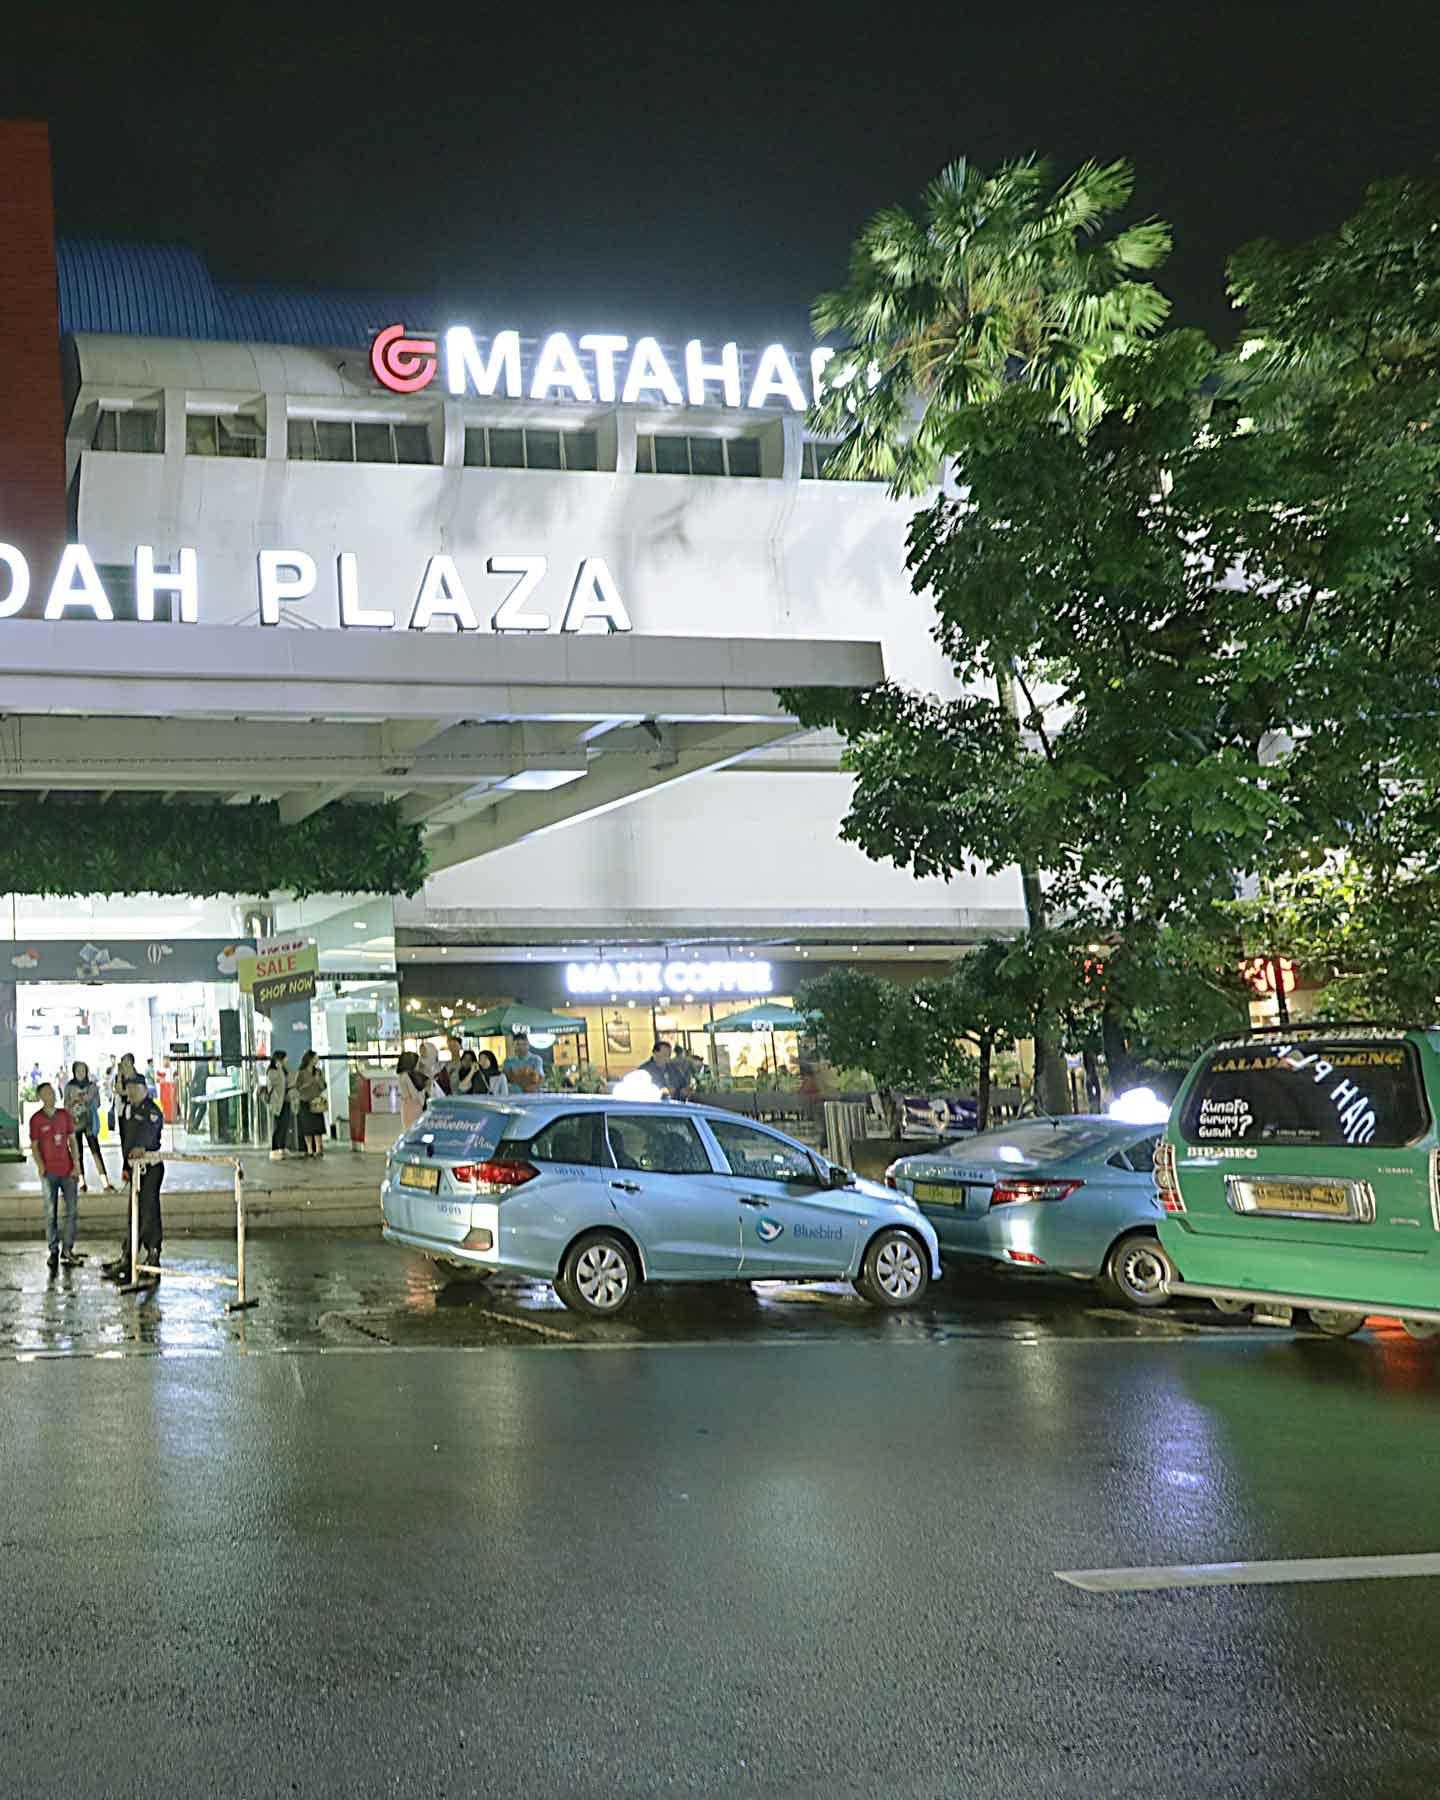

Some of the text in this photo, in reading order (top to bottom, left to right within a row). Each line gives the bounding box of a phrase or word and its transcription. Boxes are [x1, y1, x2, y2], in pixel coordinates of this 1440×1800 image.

[257, 550, 632, 632] PLAZA
[256, 955, 296, 977] SALE
[664, 962, 773, 993] COFFEE
[260, 977, 313, 1002] SHOP NOW
[794, 1224, 842, 1240] Bluebird
